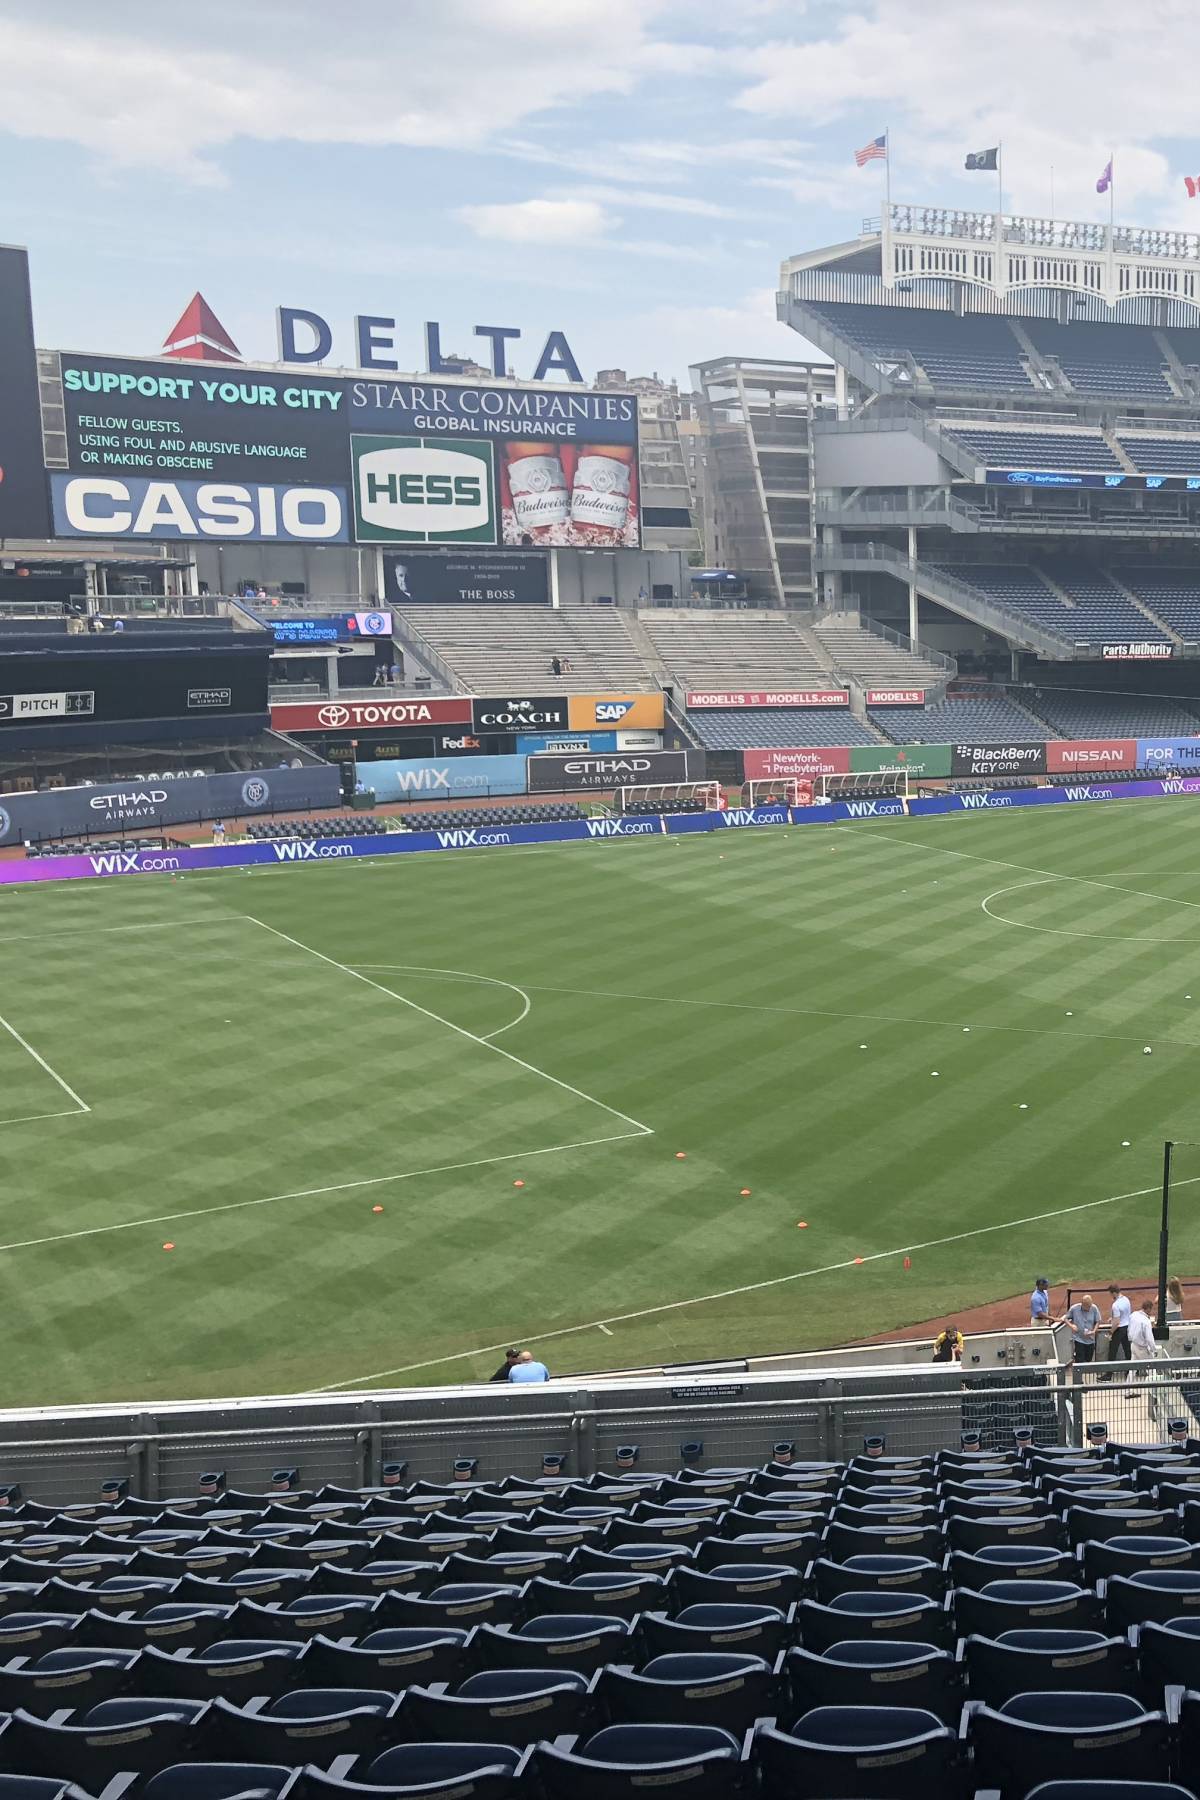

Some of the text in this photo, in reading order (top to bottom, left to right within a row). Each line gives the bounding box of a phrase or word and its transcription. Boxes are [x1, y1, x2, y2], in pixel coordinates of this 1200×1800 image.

[275, 305, 584, 383] DELTA
[64, 368, 343, 411] SUPPORT YOUR CITY
[352, 383, 633, 421] STARR COMPANIES
[78, 415, 184, 434] FELLOW GUESTS.
[414, 415, 577, 437] GLOBAL INSURANCE
[79, 434, 308, 459] USING FOUL AND ABUSIVE LANGUAGE
[80, 451, 214, 470] OR MAKING OBSCENE
[1104, 477, 1121, 487] SAP
[1146, 478, 1162, 488] SAP
[366, 472, 481, 507] HESS
[65, 478, 342, 538] CASIO
[459, 589, 516, 600] THE BOSS
[1102, 643, 1172, 656] Parts Authority
[190, 691, 229, 700] ETIHAD
[692, 694, 844, 704] MODELL'S MODELLS.com
[872, 692, 918, 701] MODELL'S
[20, 699, 59, 711] PITCH
[596, 704, 627, 720] SAP
[351, 704, 432, 723] TOYOTA
[480, 712, 561, 725] COACH
[442, 736, 481, 750] FedEx
[972, 747, 1041, 761] BlackBerry
[1061, 749, 1124, 762] NISSAN
[1146, 748, 1173, 760] FOR
[563, 760, 652, 774] ETIHAD
[773, 763, 835, 774] Presbyterian
[580, 774, 637, 785] AIRWAYS
[89, 790, 168, 810] ETIHAD
[105, 807, 156, 820] AIRWAYS
